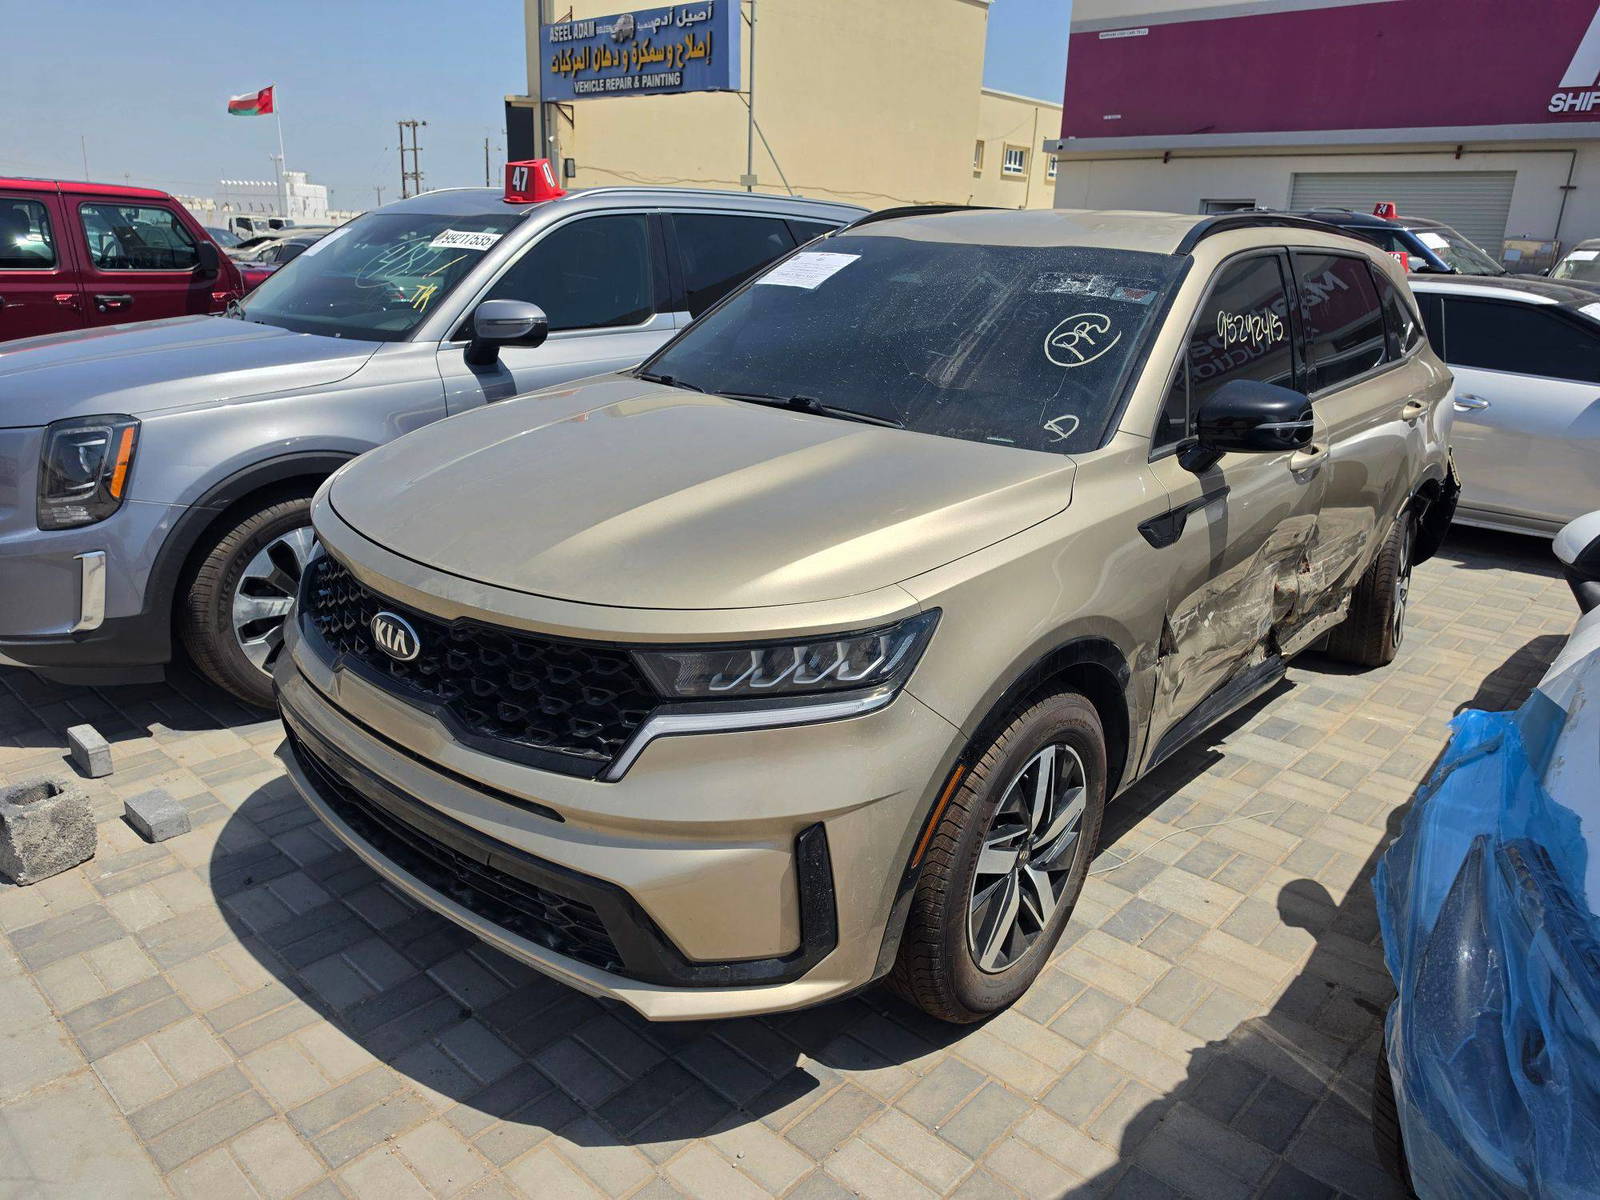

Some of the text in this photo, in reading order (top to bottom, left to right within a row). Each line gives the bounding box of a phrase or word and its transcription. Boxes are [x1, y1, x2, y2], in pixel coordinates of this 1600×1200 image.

[676, 2, 712, 28] أصيل
[550, 25, 572, 42] ASEEL
[573, 22, 595, 40] ADAM
[551, 46, 590, 78] المركبات
[593, 44, 619, 72] دهان
[675, 31, 712, 68] إصلاح
[574, 72, 680, 94] VEHICLE REPAIR & PAINTING
[512, 166, 528, 192] 47
[1377, 203, 1388, 215] 24
[375, 618, 409, 655] KIA
